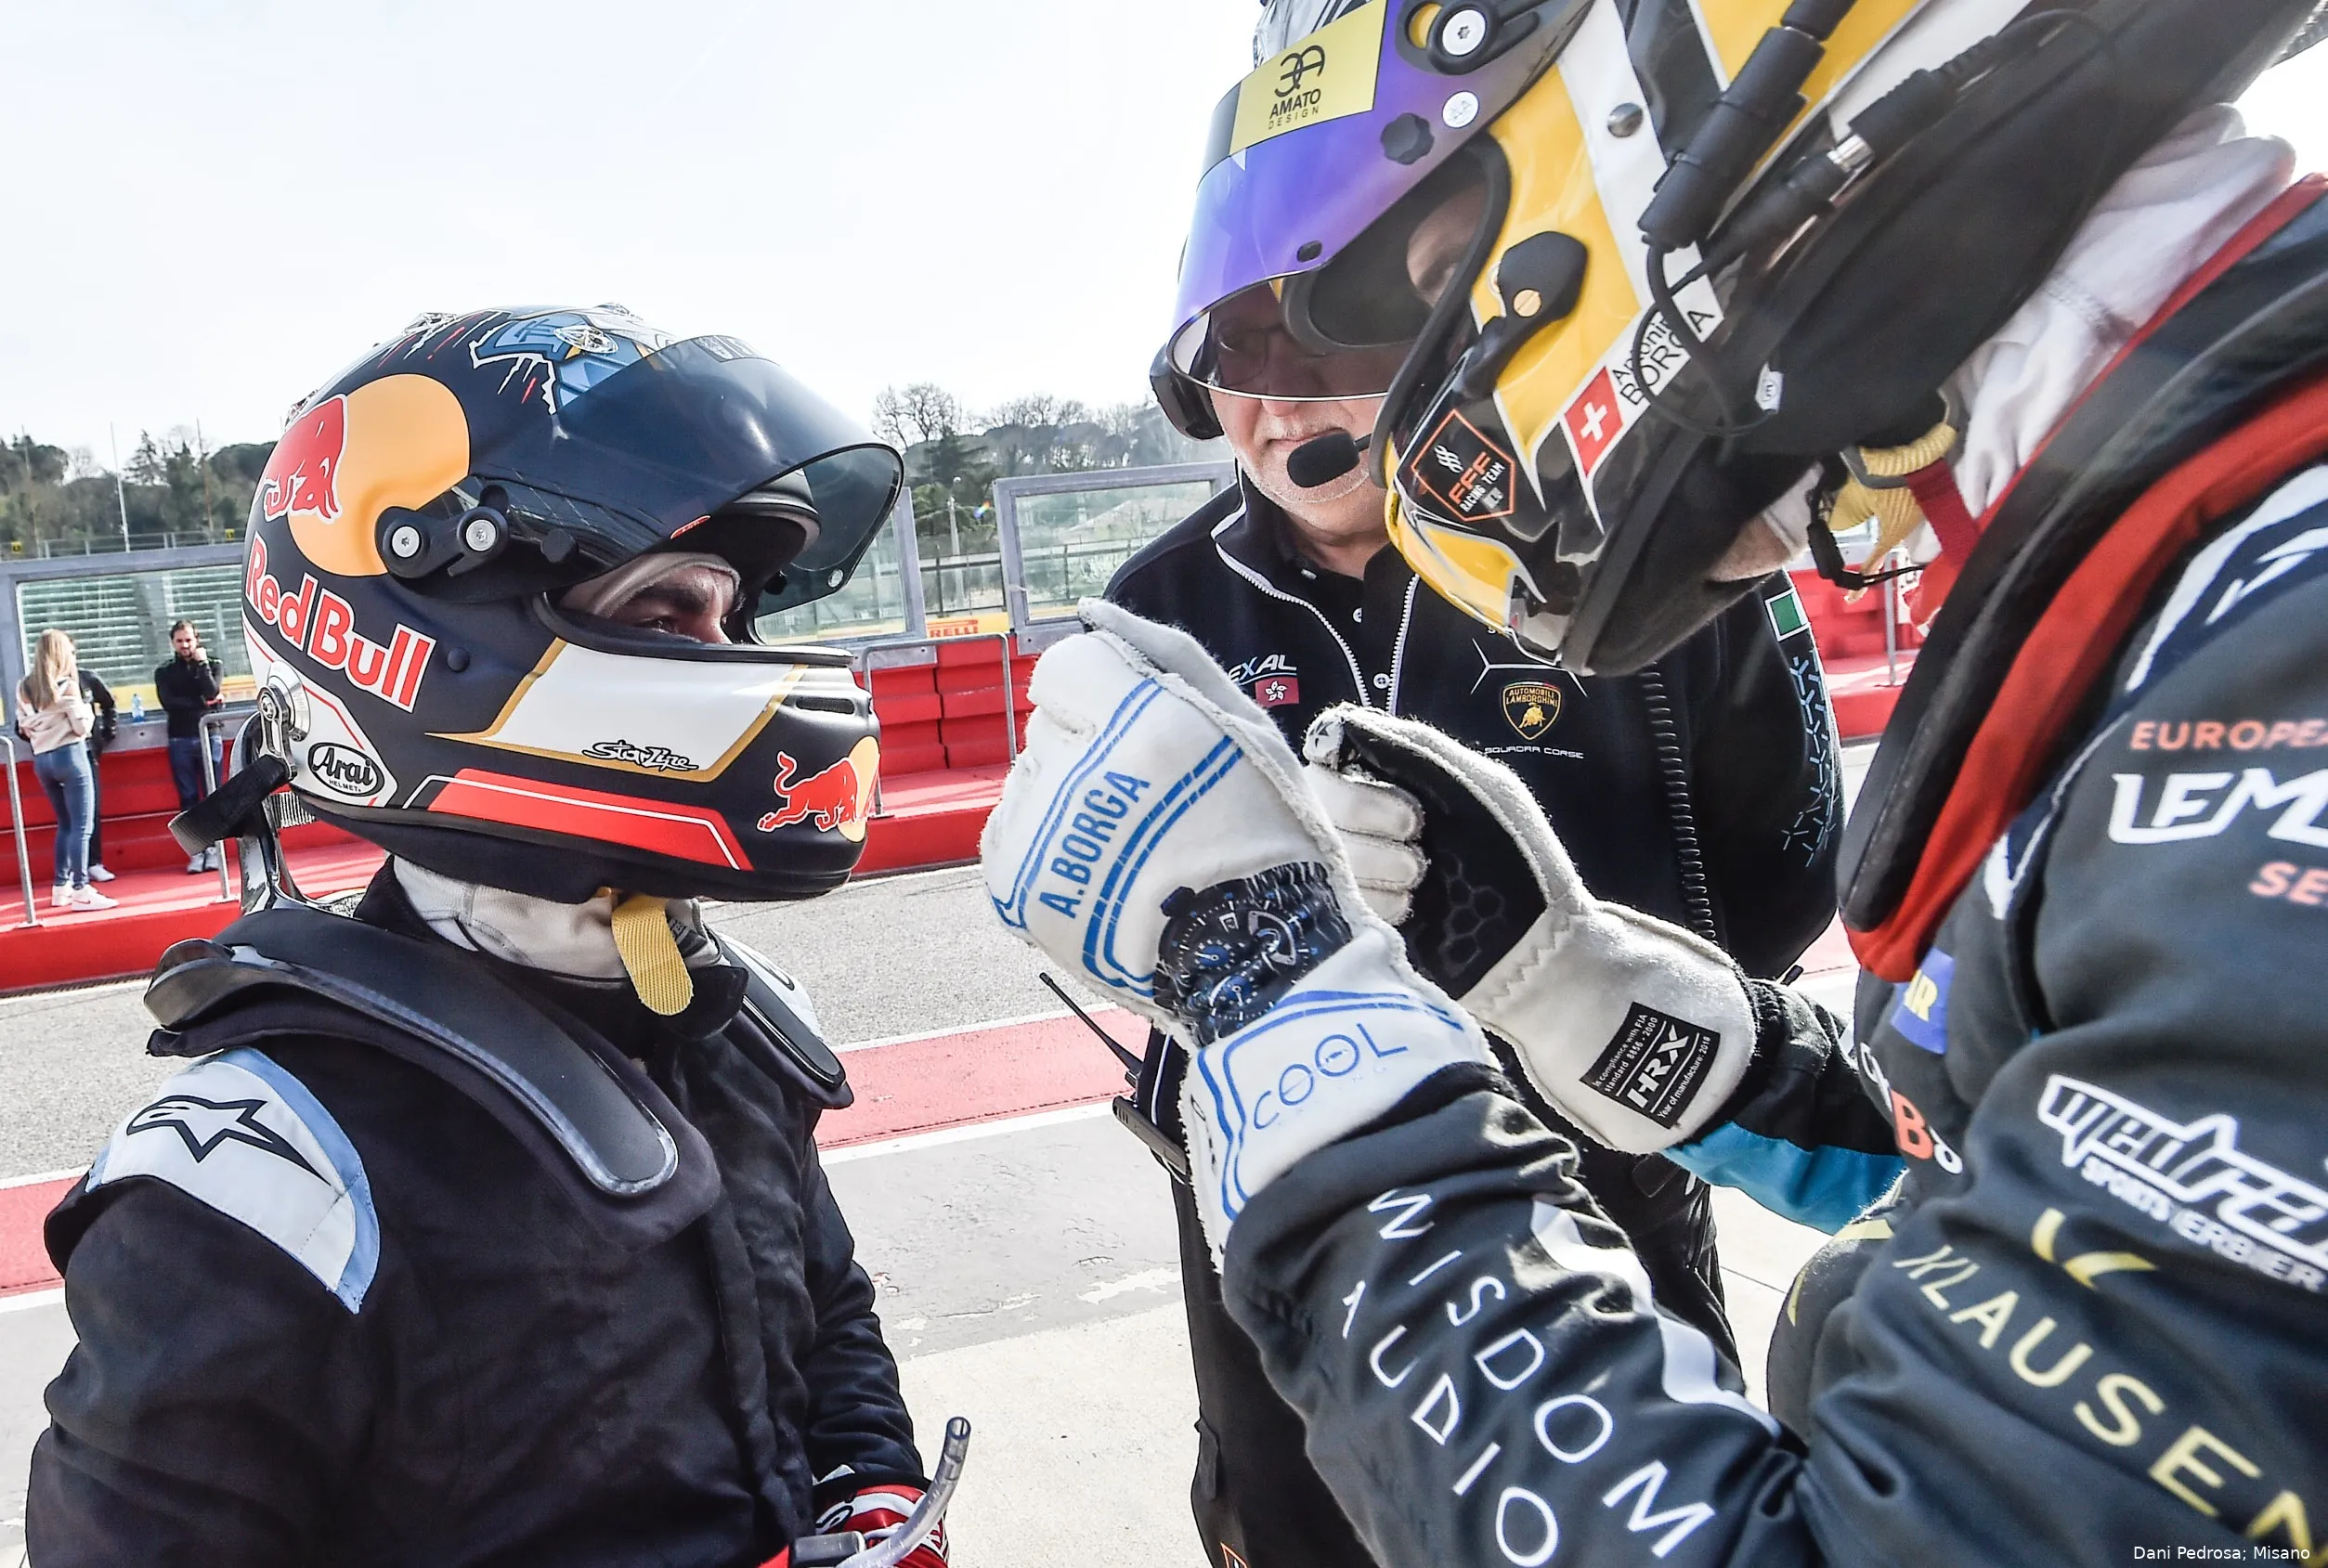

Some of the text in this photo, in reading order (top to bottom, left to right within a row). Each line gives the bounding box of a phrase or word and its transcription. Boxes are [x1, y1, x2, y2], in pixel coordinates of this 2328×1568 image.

[1268, 107, 1320, 130] DESIGN
[1269, 88, 1322, 120] AMATO
[1612, 317, 1671, 385] Anoni
[1449, 451, 1490, 504] FFF
[1460, 484, 1486, 512] RACING
[1482, 461, 1506, 486] TEAM
[245, 530, 437, 714] Red Bull
[1505, 694, 1558, 707] LAMBORGHINI
[1509, 688, 1554, 698] AUTOMOBILI
[312, 747, 374, 786] Arai
[1485, 745, 1584, 759] SQUADRA CORSE
[329, 779, 358, 792] HELMET
[1039, 771, 1151, 919] A.BORGA
[1254, 1023, 1409, 1129] COOL
[1599, 1043, 1628, 1082] compliance
[1626, 1027, 1640, 1043] with
[1635, 1014, 1648, 1029] FIA
[1605, 1062, 1630, 1093] standard
[1643, 1017, 1658, 1037] 2000
[1626, 1024, 1689, 1109] HRX
[1658, 1104, 1672, 1119] Year
[1670, 1095, 1678, 1105] of
[1675, 1055, 1705, 1099] manufacture:
[1367, 1188, 1715, 1559] WISDOM
